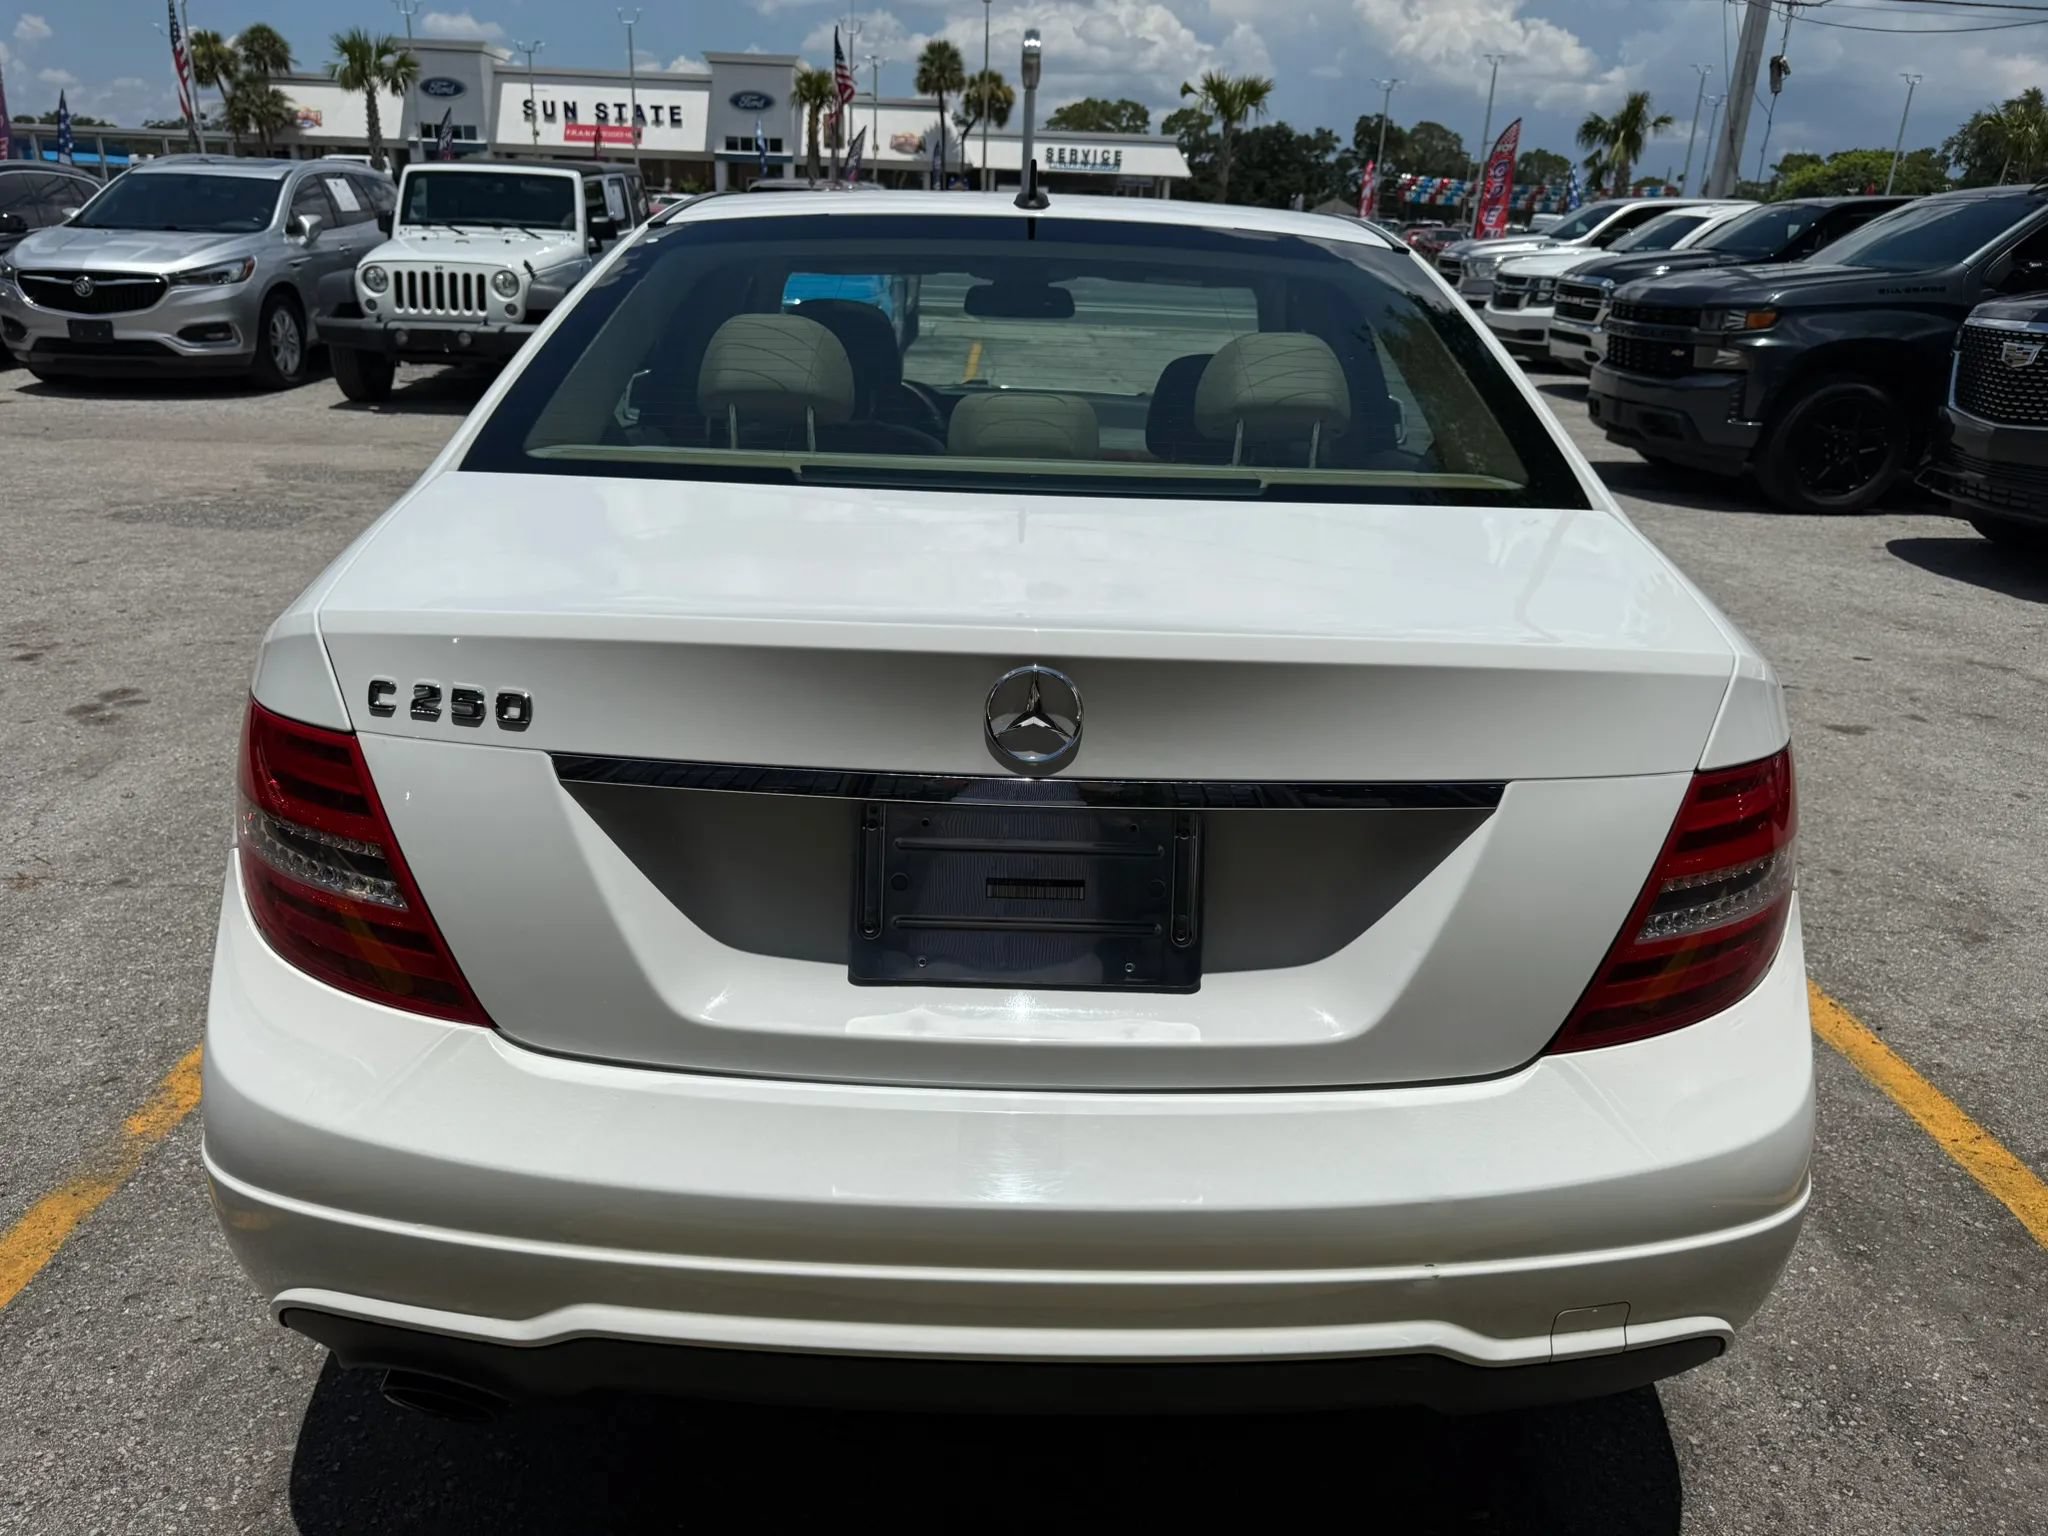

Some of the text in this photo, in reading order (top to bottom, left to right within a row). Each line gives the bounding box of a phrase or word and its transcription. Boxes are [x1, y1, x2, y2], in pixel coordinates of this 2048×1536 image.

[523, 100, 682, 123] SUN STATE
[1046, 148, 1122, 164] SERVICE
